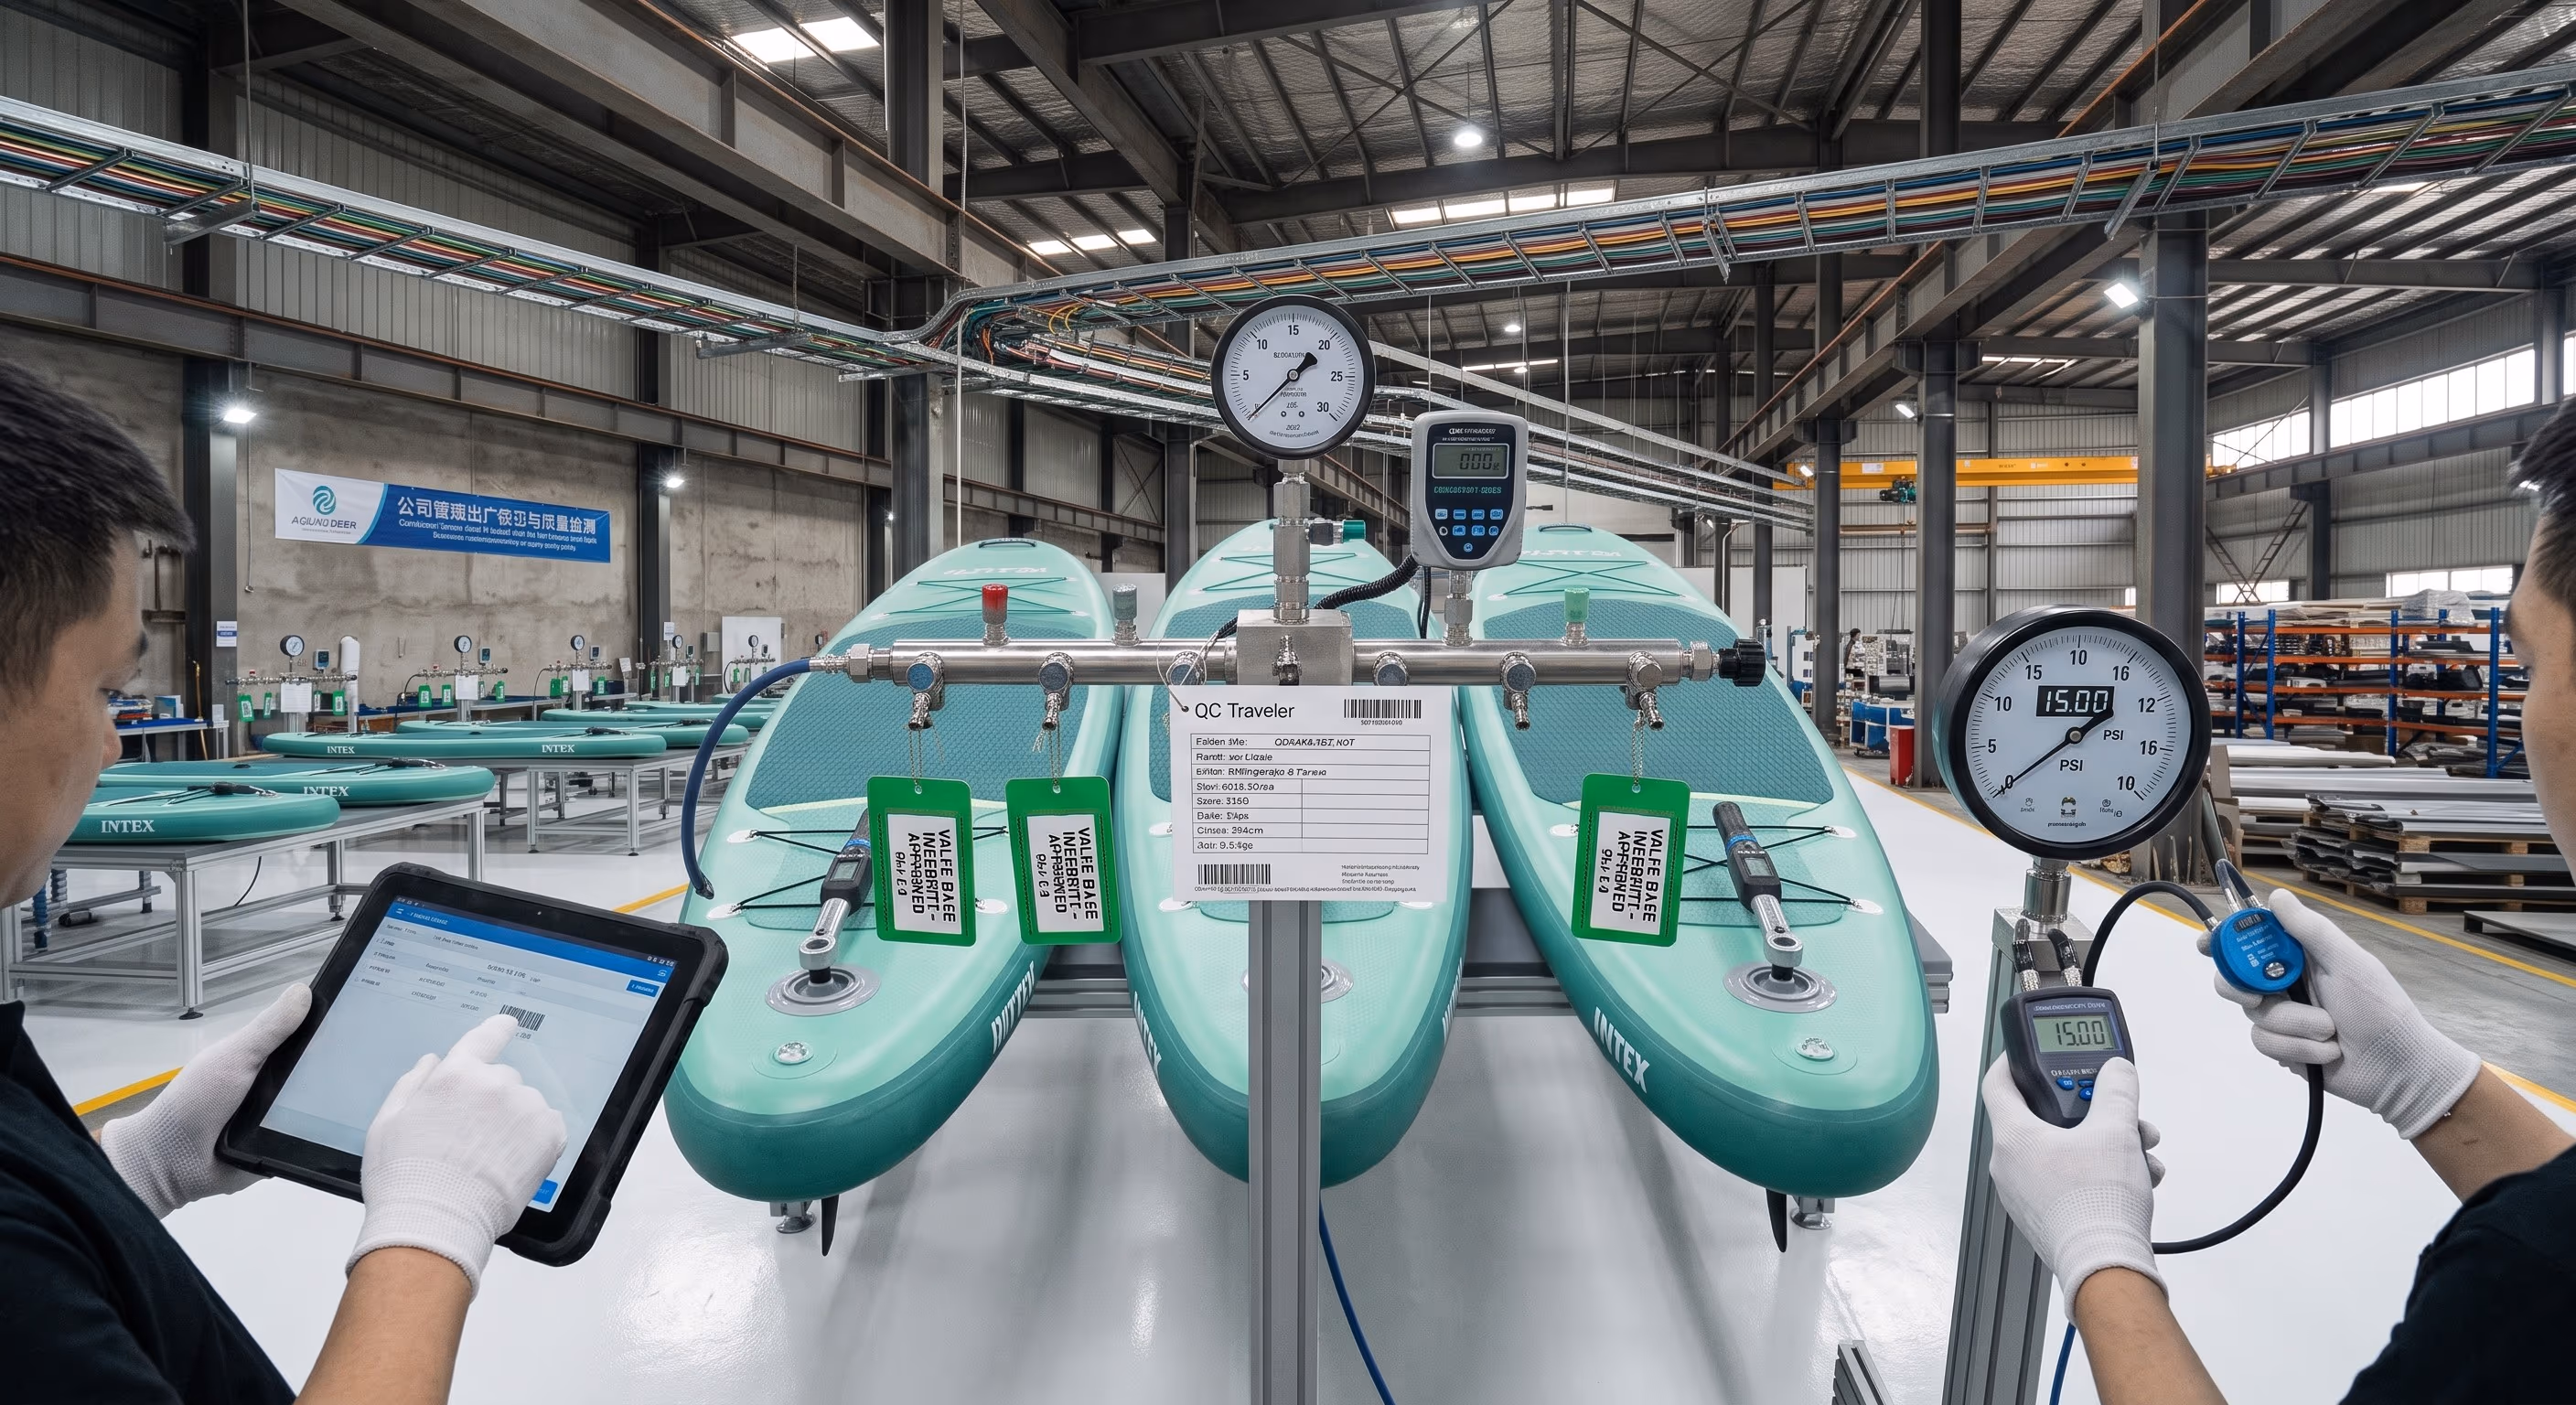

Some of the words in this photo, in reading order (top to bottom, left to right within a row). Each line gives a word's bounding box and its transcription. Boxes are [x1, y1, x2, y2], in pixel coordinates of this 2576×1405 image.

[1288, 325, 1299, 335] 15
[1257, 338, 1268, 349] 10
[1318, 339, 1330, 349] 20
[1242, 370, 1250, 381] 5
[1330, 371, 1343, 381] 25
[1317, 402, 1329, 412] 30
[331, 520, 357, 529] DEER
[2070, 649, 2088, 665] 10
[2025, 665, 2042, 680] 15
[2113, 666, 2130, 681] 16
[1994, 697, 2012, 712] 10
[2045, 690, 2109, 713] 15.00
[2139, 698, 2155, 713] 12
[1195, 702, 1222, 719] QC
[1228, 702, 1295, 719] Traveler
[2103, 730, 2124, 741] PSI
[327, 745, 355, 754] INTEX
[1988, 739, 1996, 753] 5
[2141, 741, 2158, 756] 16
[2060, 760, 2083, 771] PSI
[2117, 776, 2135, 790] 10
[101, 820, 156, 833] INTEX
[2056, 1021, 2106, 1046] 15.00
[1594, 1006, 1650, 1094] INTEX
